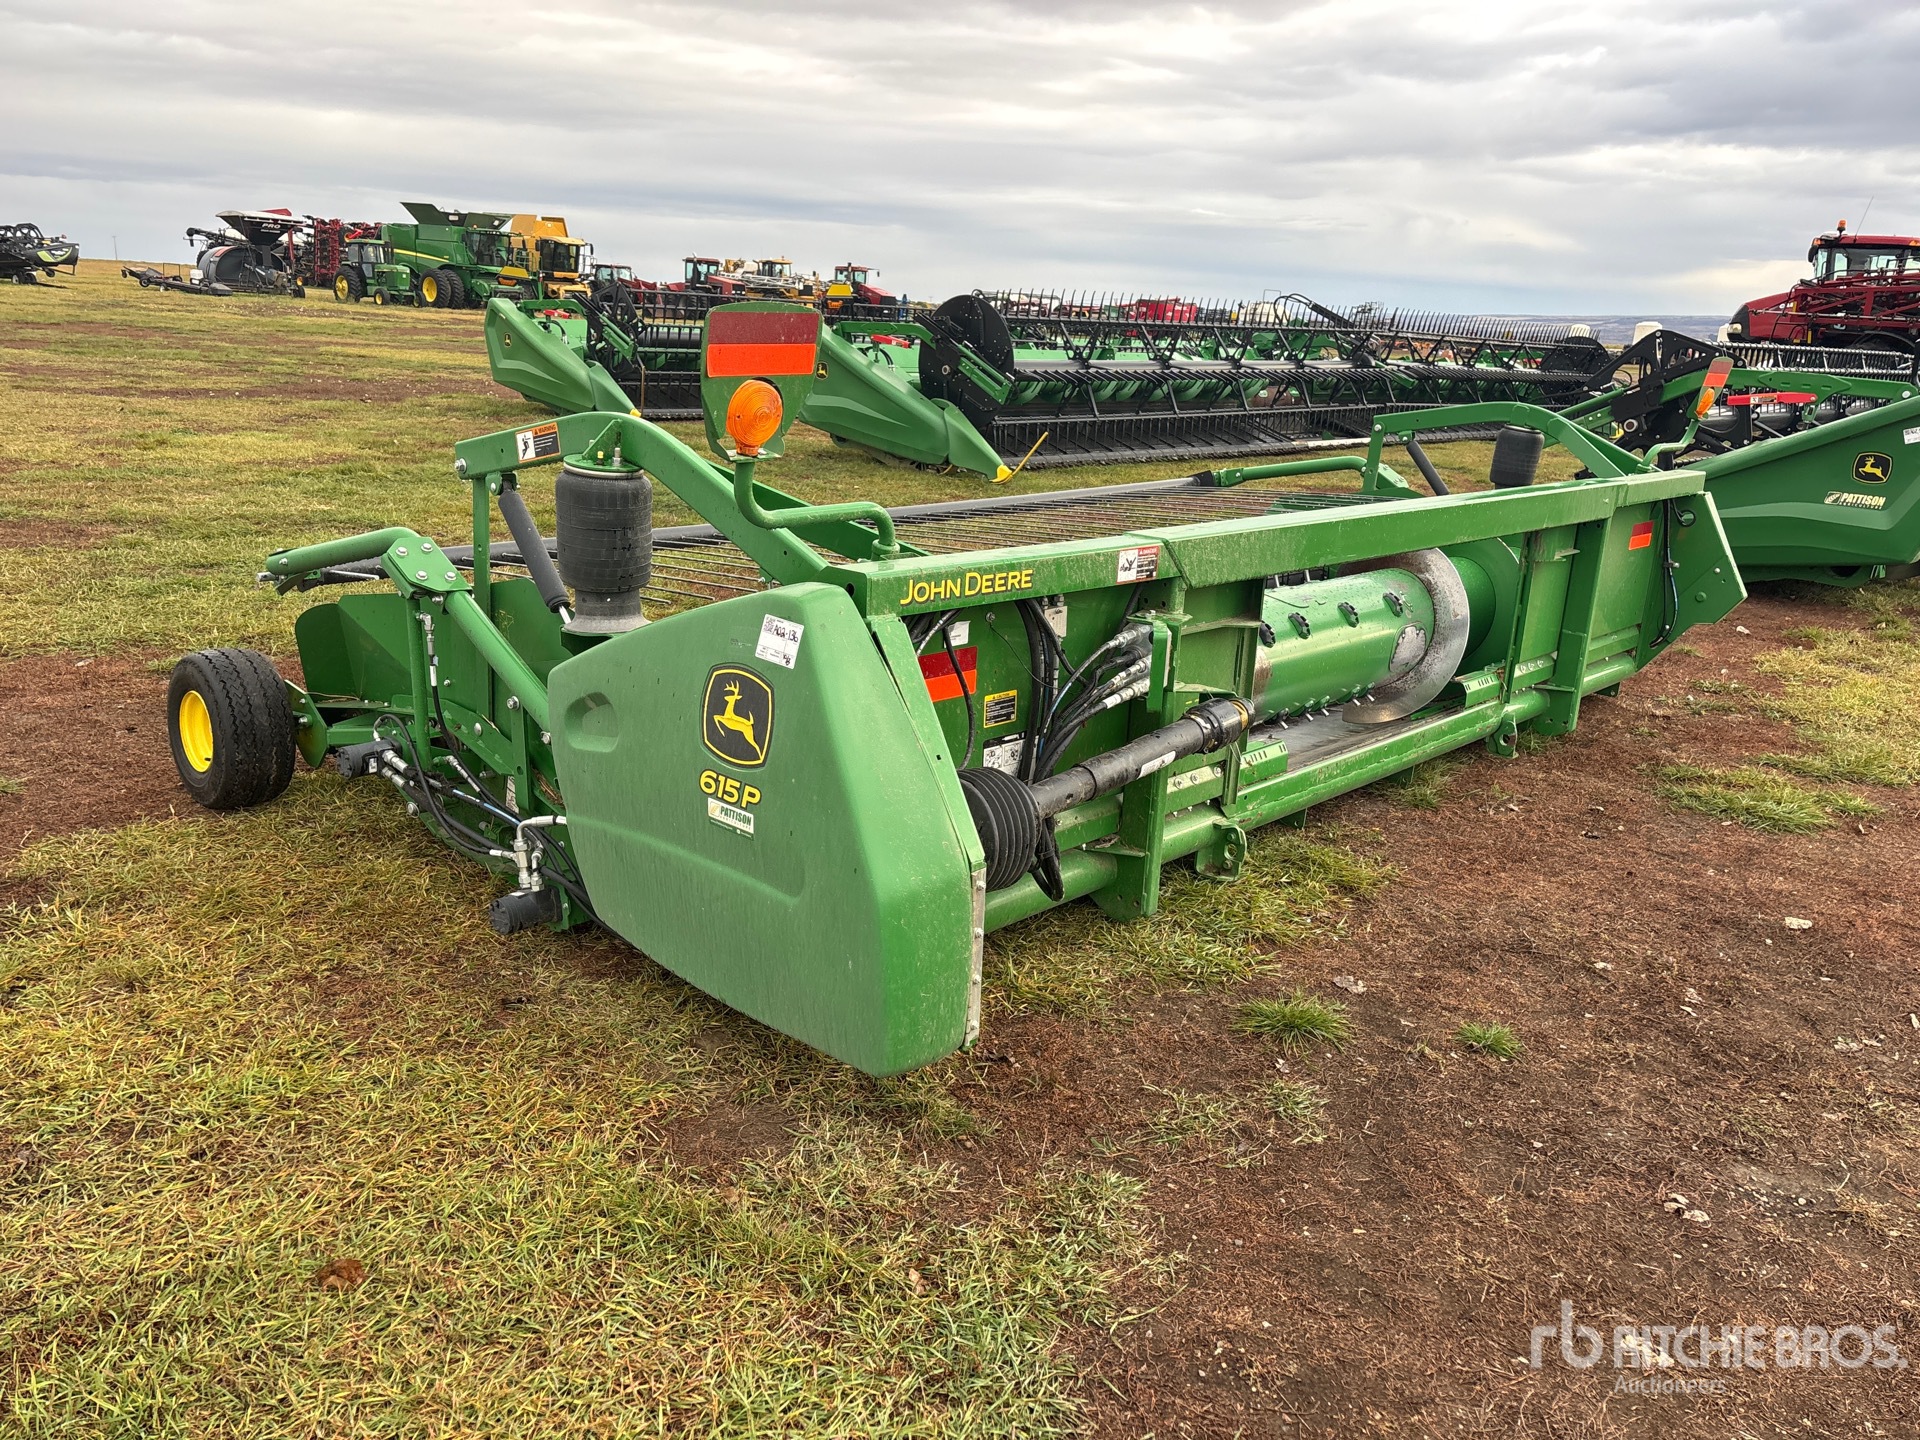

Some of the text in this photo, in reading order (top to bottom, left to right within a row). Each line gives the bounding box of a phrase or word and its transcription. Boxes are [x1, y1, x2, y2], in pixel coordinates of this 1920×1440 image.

[1841, 493, 1886, 506] PATTISON
[899, 569, 1034, 605] JOHN DEERE
[699, 769, 761, 809] 615P
[720, 806, 752, 826] PATTISON
